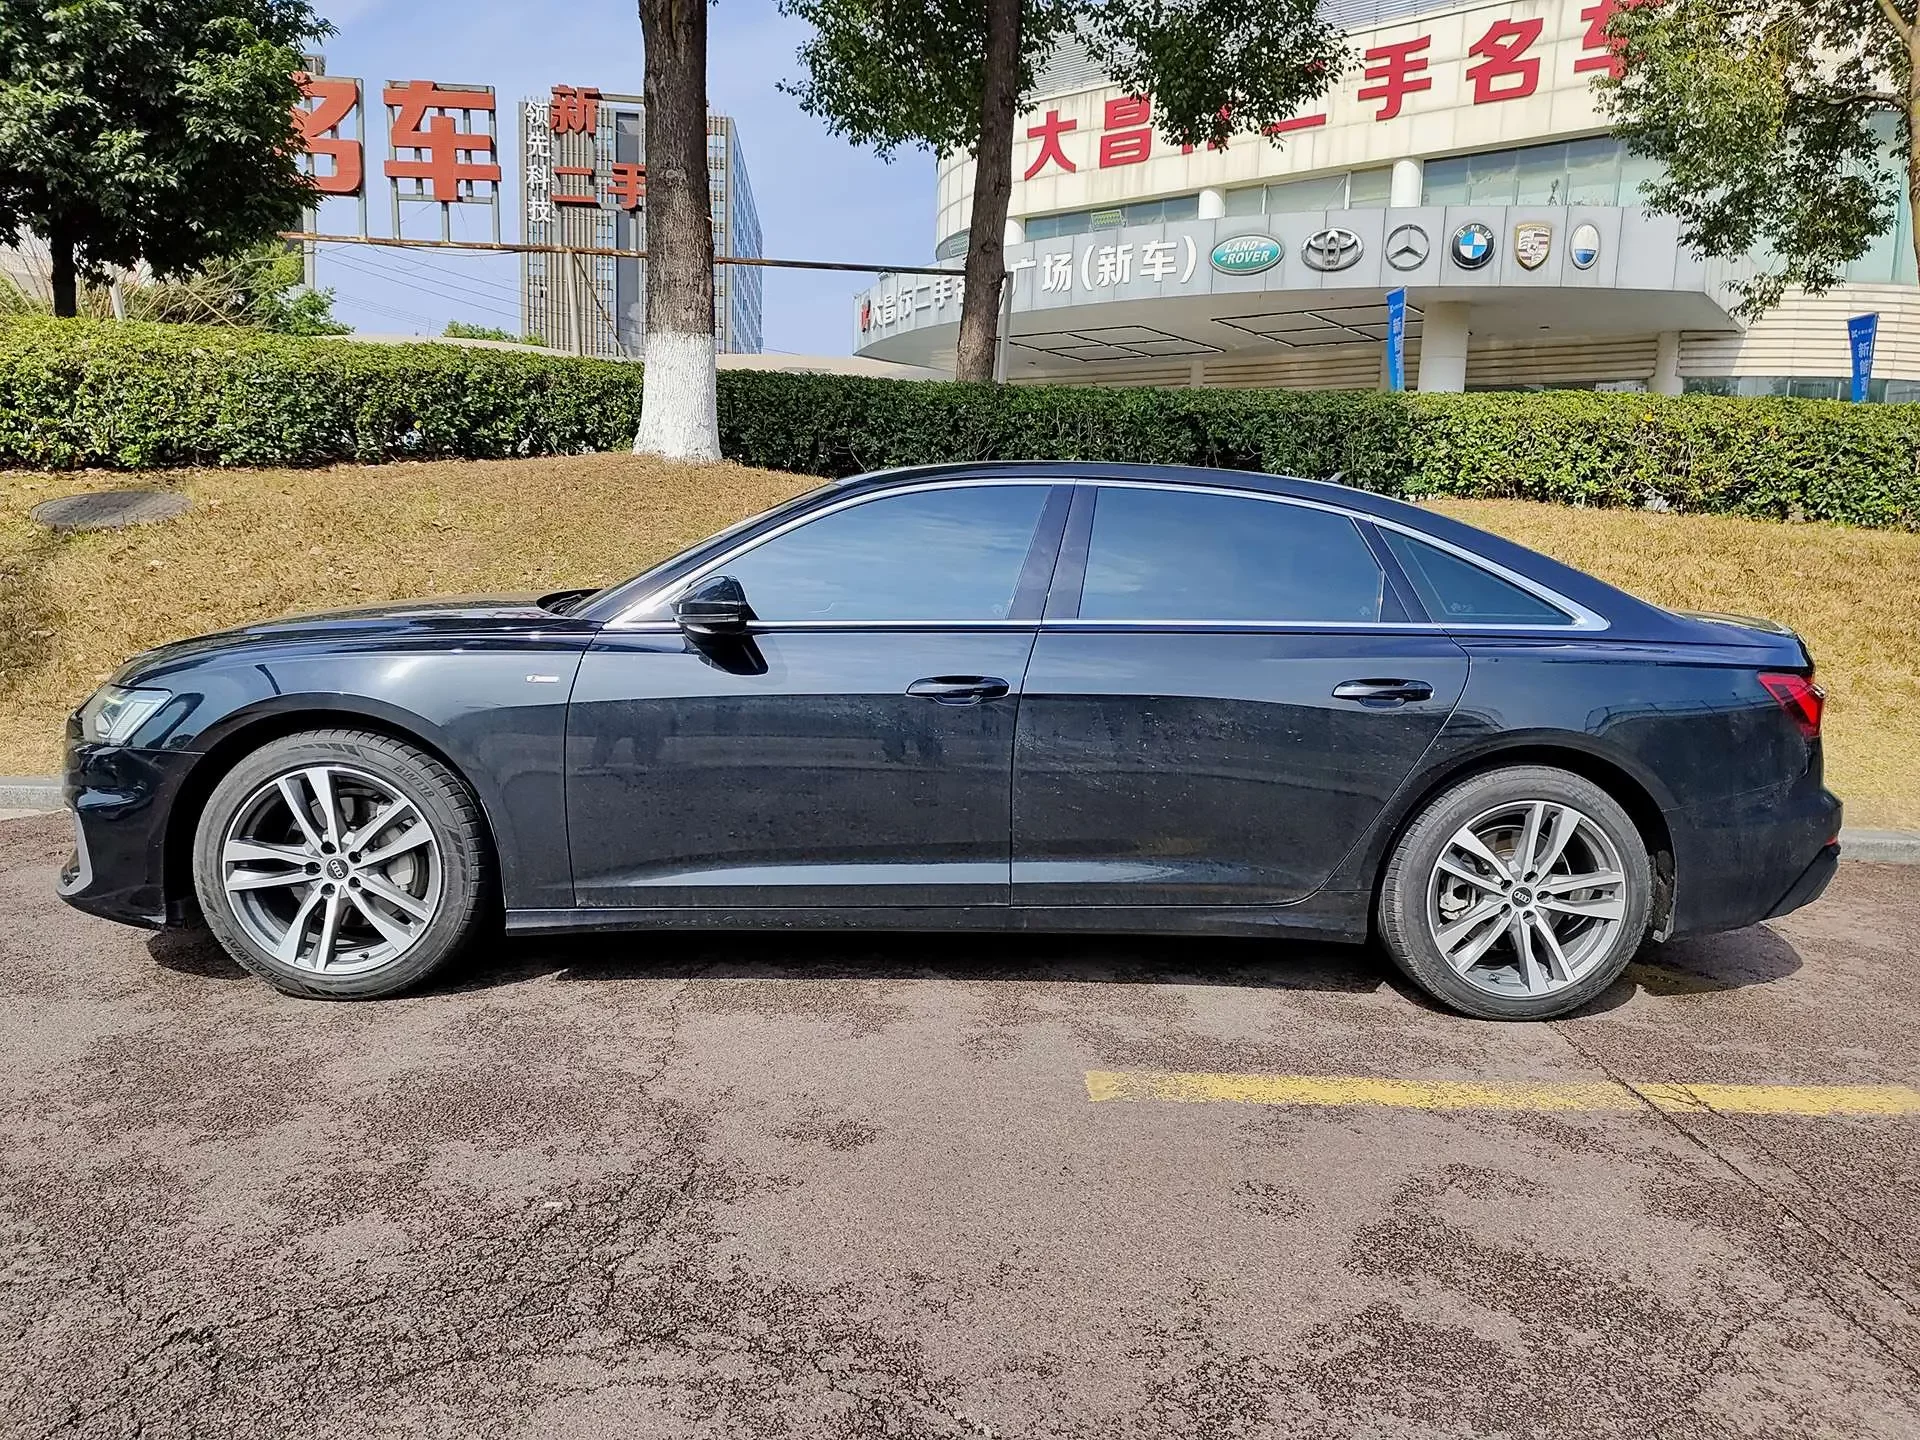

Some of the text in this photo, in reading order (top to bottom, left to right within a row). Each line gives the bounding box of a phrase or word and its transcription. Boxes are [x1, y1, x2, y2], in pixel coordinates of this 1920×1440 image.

[550, 84, 599, 134] 新
[1024, 0, 1648, 181] 大昌手名车
[525, 101, 551, 223] 领先科技
[550, 161, 646, 210] 二手
[1225, 240, 1259, 254] LAND
[1455, 224, 1493, 240] BMW
[1227, 250, 1271, 265] ROVER
